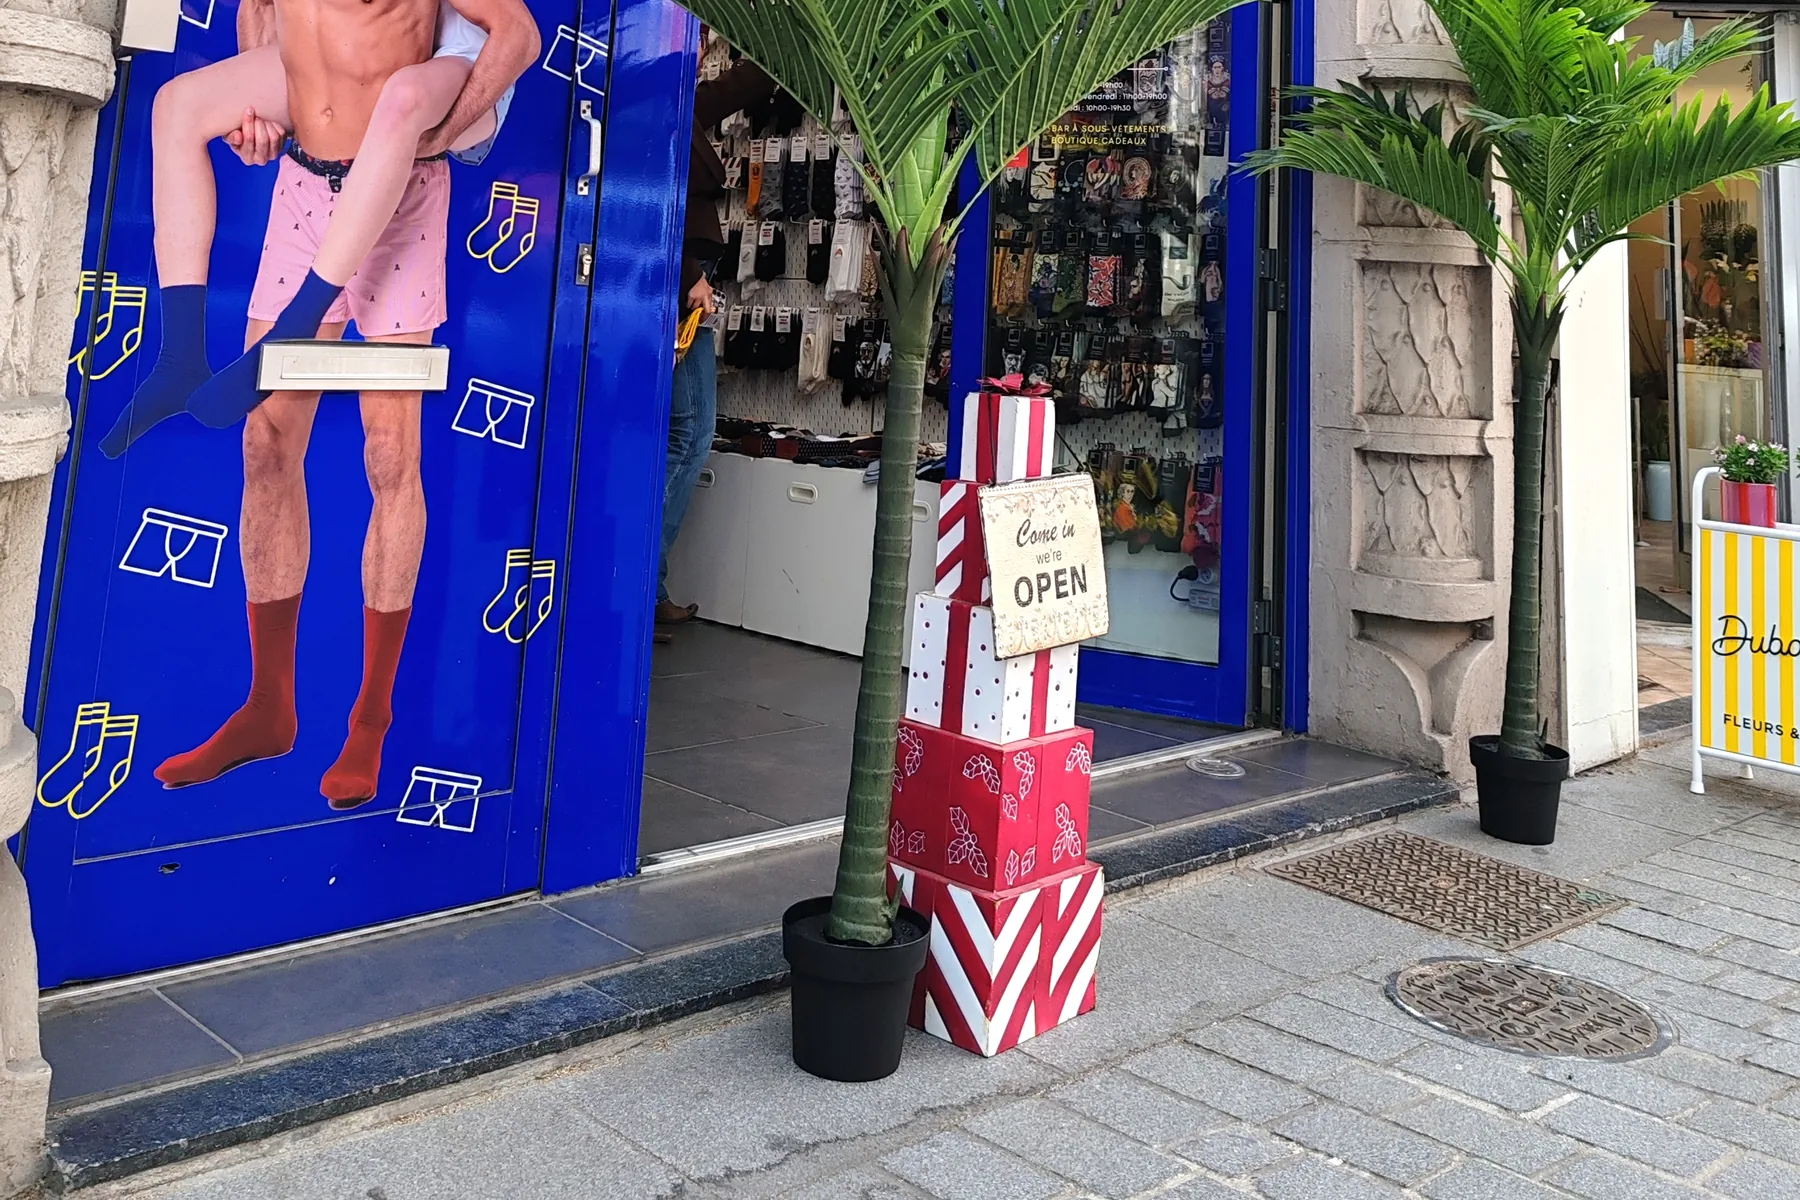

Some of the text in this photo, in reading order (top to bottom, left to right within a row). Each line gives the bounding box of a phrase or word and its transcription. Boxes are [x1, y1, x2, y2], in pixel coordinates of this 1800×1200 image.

[1051, 124, 1070, 132] BAR
[1051, 137, 1147, 145] BOUTIQUE CADEAUX
[1016, 518, 1076, 548] Come in
[1036, 548, 1062, 564] we're
[1014, 563, 1088, 607] OPEN
[1723, 713, 1784, 736] FLEURS
